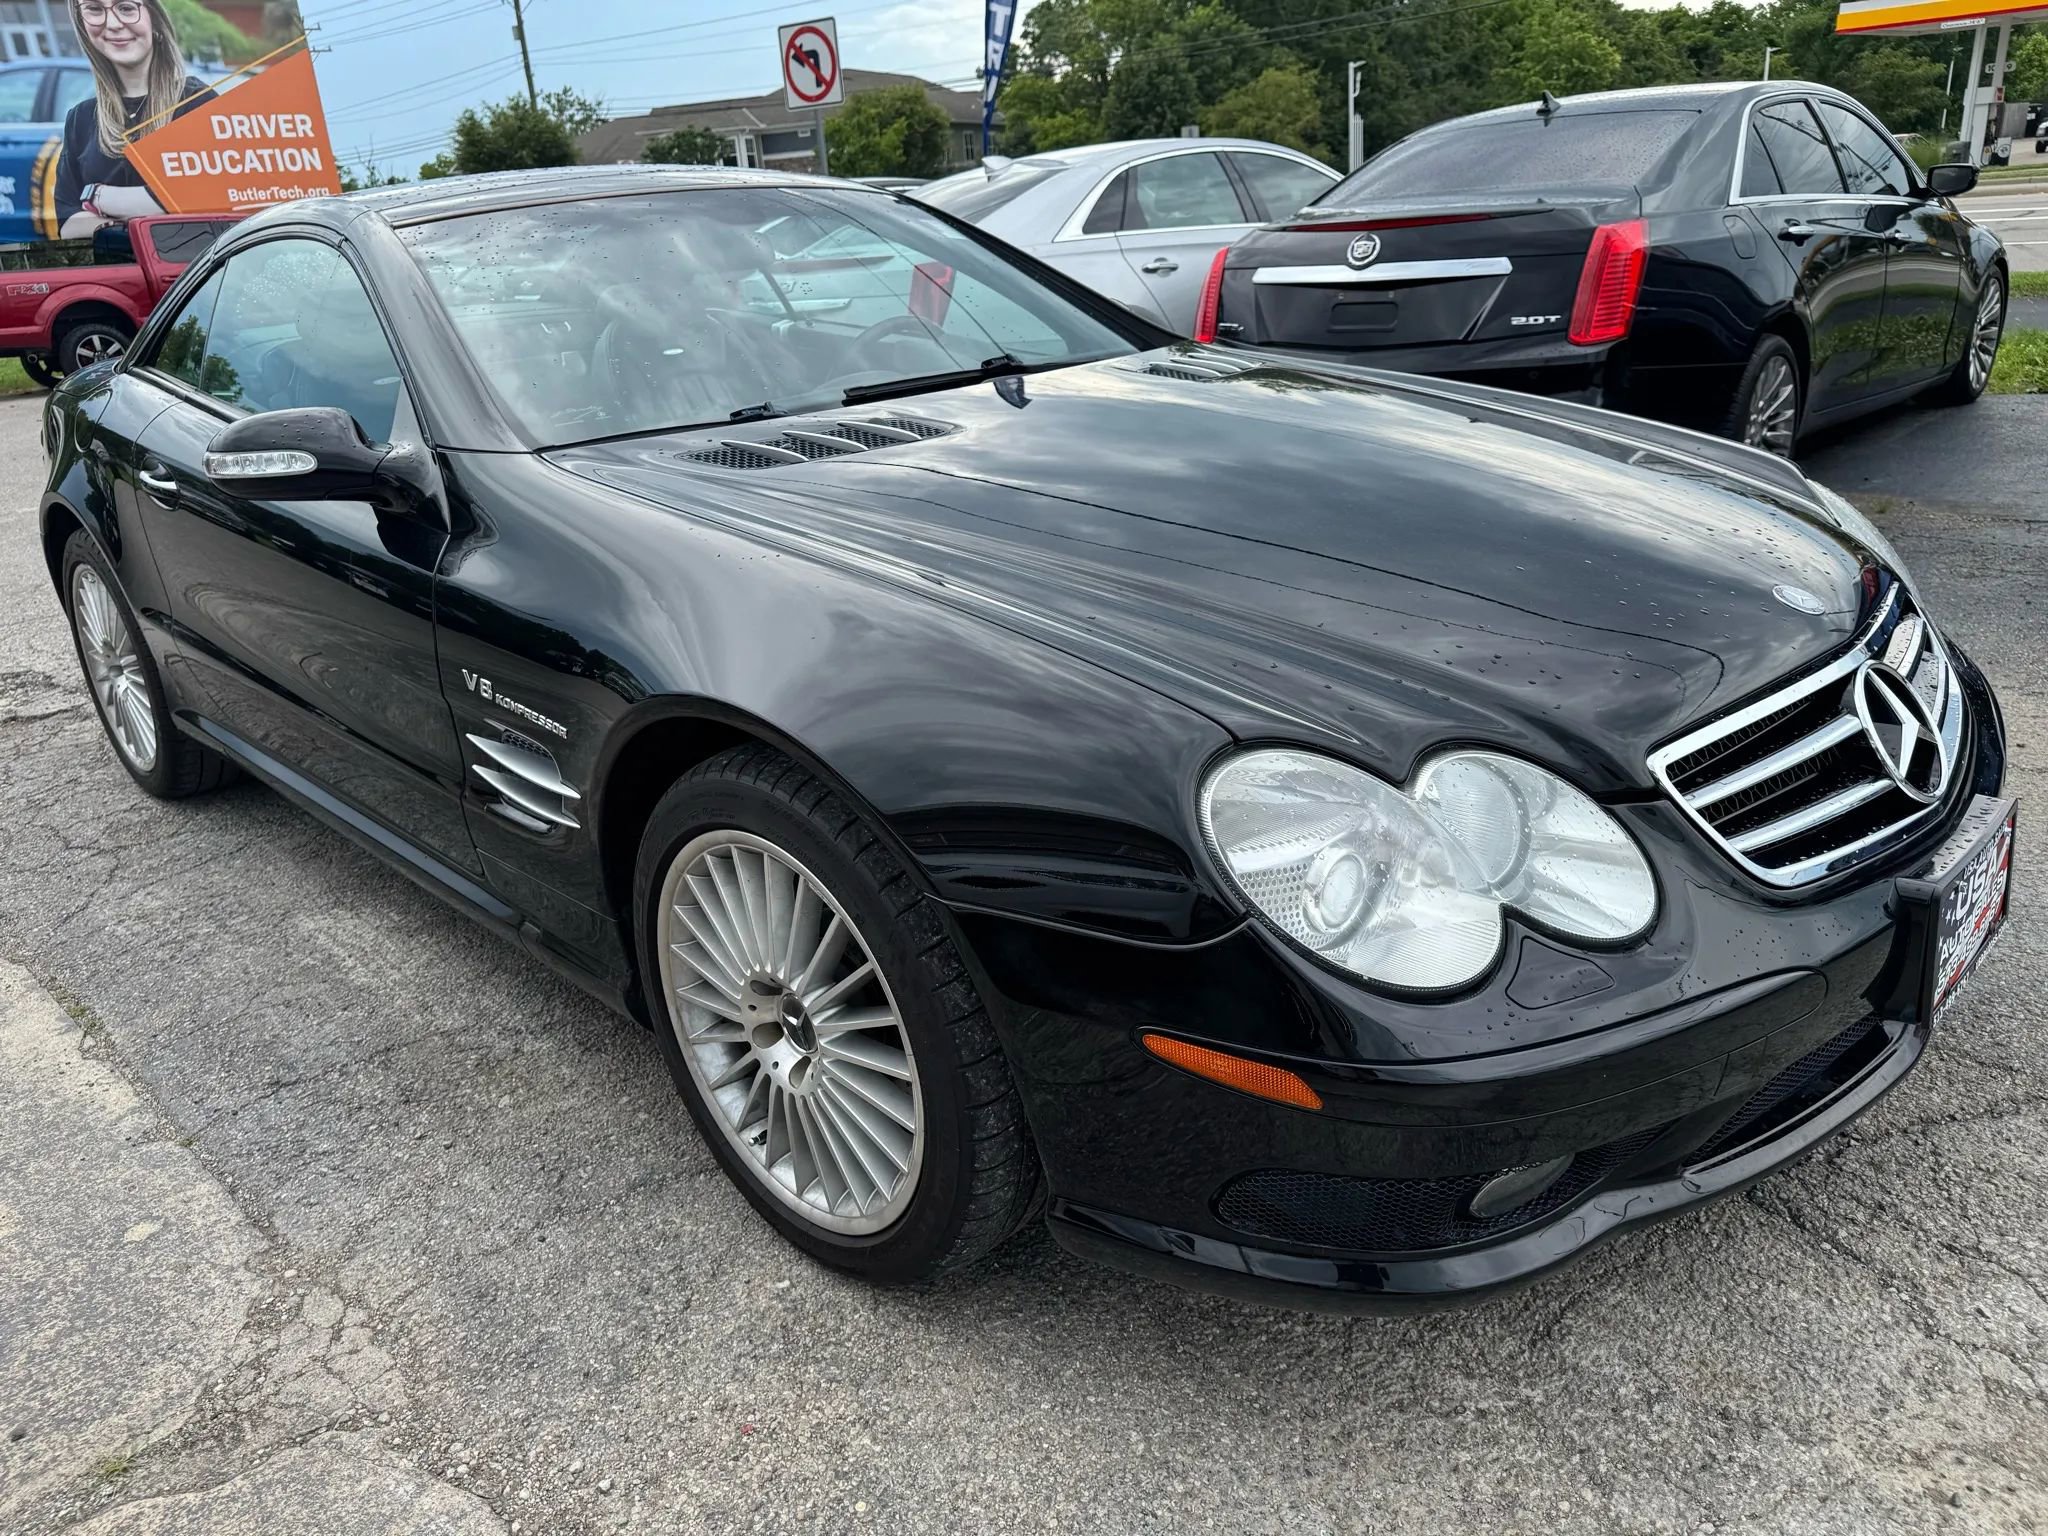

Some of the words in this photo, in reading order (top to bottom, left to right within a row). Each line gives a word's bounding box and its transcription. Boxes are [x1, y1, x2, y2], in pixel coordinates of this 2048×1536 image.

[210, 113, 315, 140] DRIVER
[160, 147, 323, 177] EDUCATION
[227, 184, 330, 202] ButlerTech.org
[6, 282, 50, 296] FX4
[461, 668, 493, 701] V8
[495, 693, 568, 740] KOMPRESSOR
[1956, 845, 1998, 921] USA
[1940, 914, 1974, 966] AUTO
